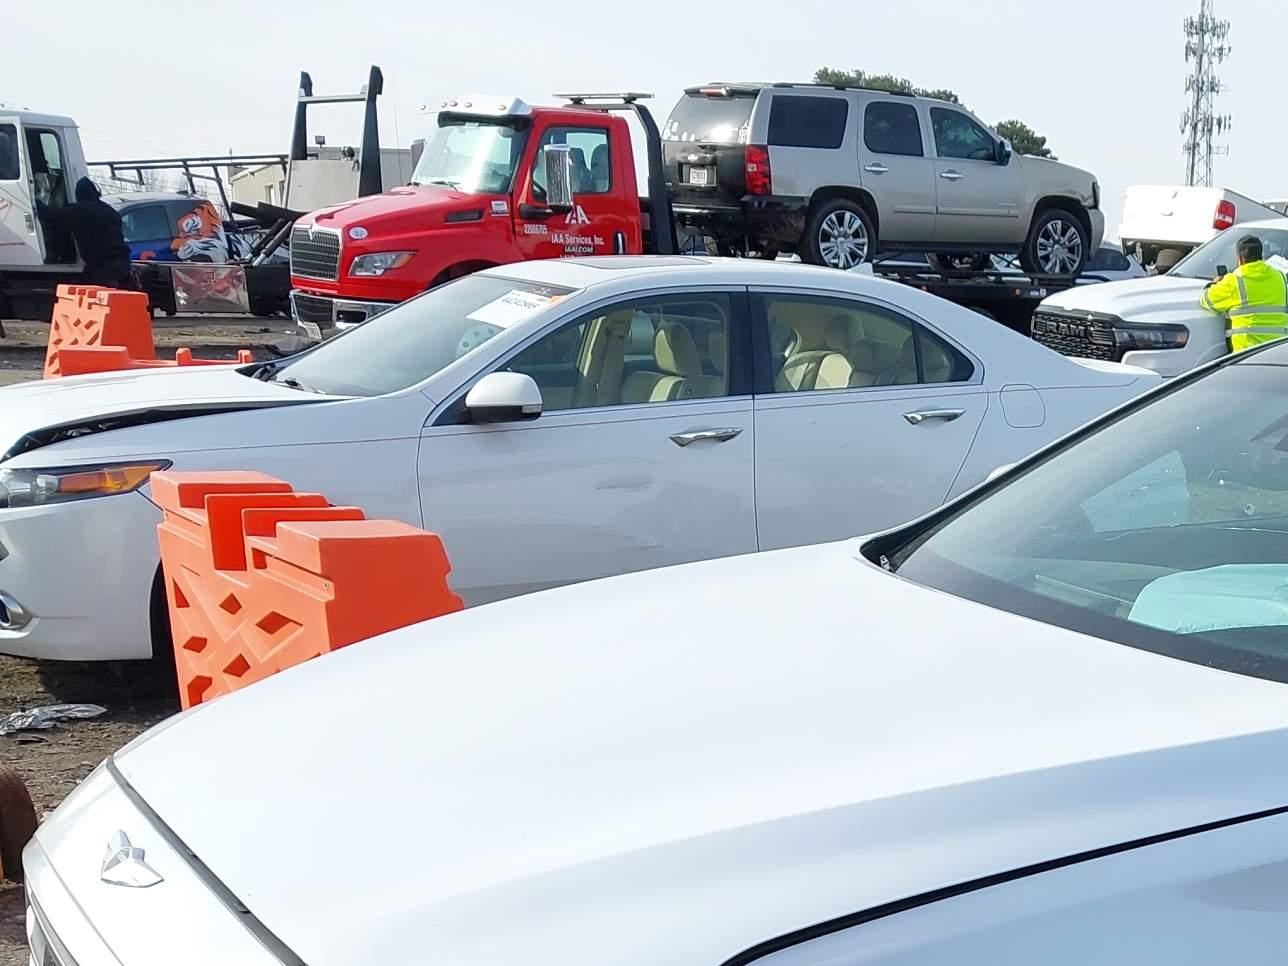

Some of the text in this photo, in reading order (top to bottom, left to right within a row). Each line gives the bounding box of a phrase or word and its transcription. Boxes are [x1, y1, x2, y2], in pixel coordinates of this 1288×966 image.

[551, 233, 605, 246] IAA Services, Inc.
[1046, 322, 1086, 338] RAM
